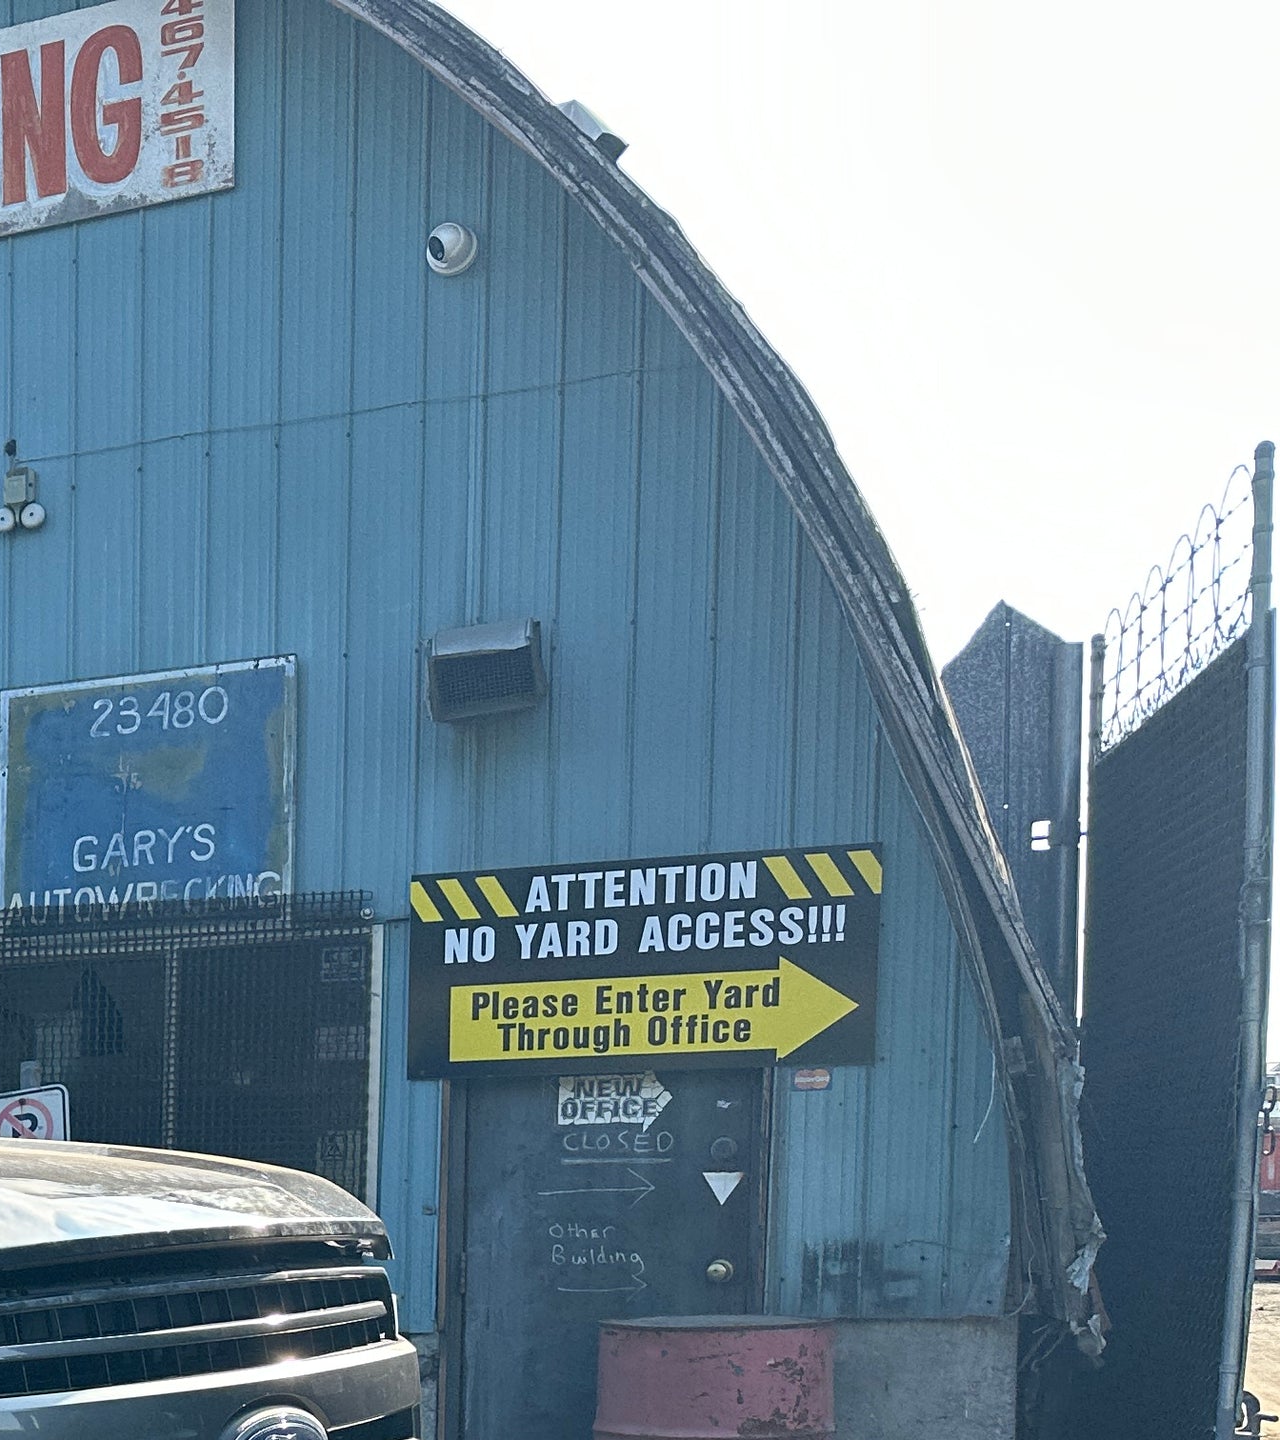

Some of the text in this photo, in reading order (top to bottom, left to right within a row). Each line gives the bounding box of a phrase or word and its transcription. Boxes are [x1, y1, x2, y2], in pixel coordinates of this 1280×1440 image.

[89, 686, 229, 738] 23480
[72, 822, 216, 873] GARY'S
[524, 860, 758, 914] ATTENTION
[443, 904, 847, 965] NO YARD ACCESS!!!
[471, 976, 781, 1022] Please Enter Yard
[496, 1014, 752, 1054] Through Office
[560, 1098, 659, 1120] OFFICE
[576, 1078, 641, 1097] NEW
[563, 1130, 674, 1153] CLOSED
[551, 1244, 646, 1272] Building
